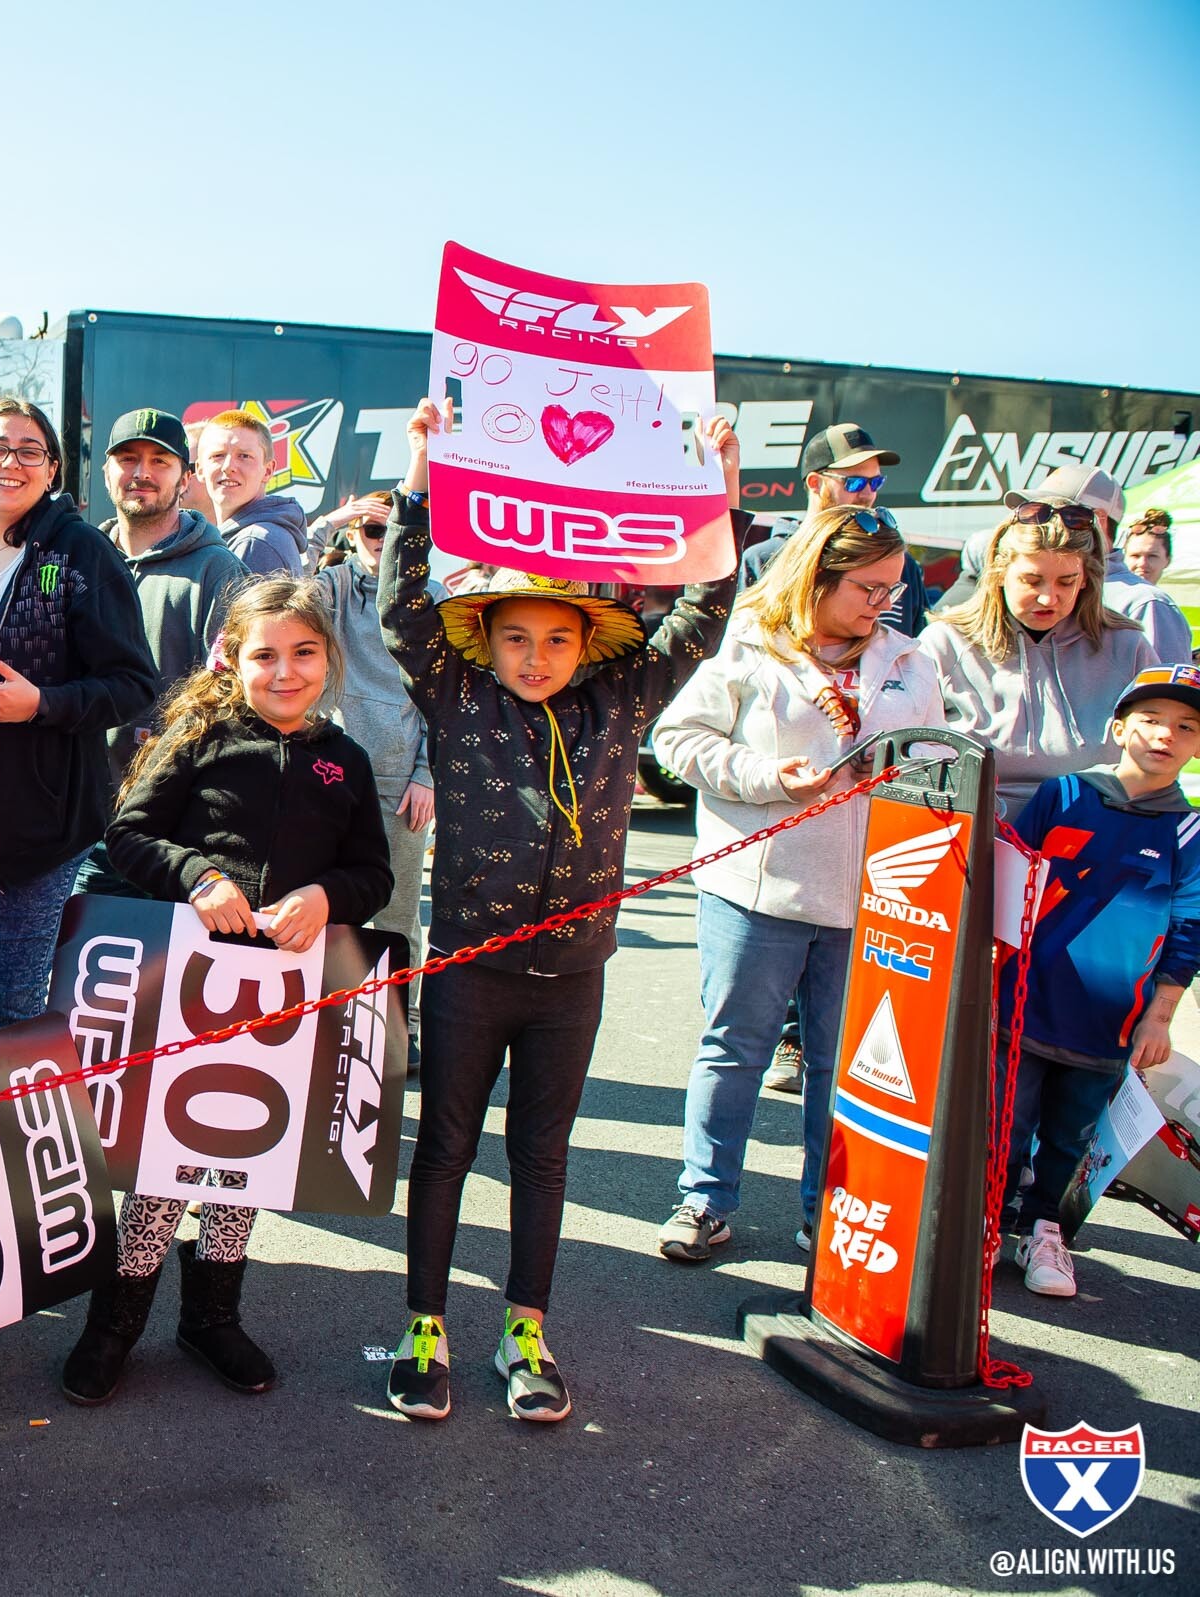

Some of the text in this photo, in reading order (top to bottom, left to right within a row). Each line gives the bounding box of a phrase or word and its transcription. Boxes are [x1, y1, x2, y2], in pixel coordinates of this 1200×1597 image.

[453, 266, 694, 338] FLY
[499, 317, 638, 349] RACING
[443, 452, 511, 472] @flyracingusa
[625, 479, 710, 492] #fearlesspursuit
[468, 489, 688, 566] WPS
[862, 891, 951, 933] HONDA
[862, 926, 935, 982] HRC
[856, 1060, 904, 1087] Pro Honda
[8, 1059, 97, 1275] WPS
[829, 1186, 892, 1232] RIDE
[829, 1221, 899, 1274] RED
